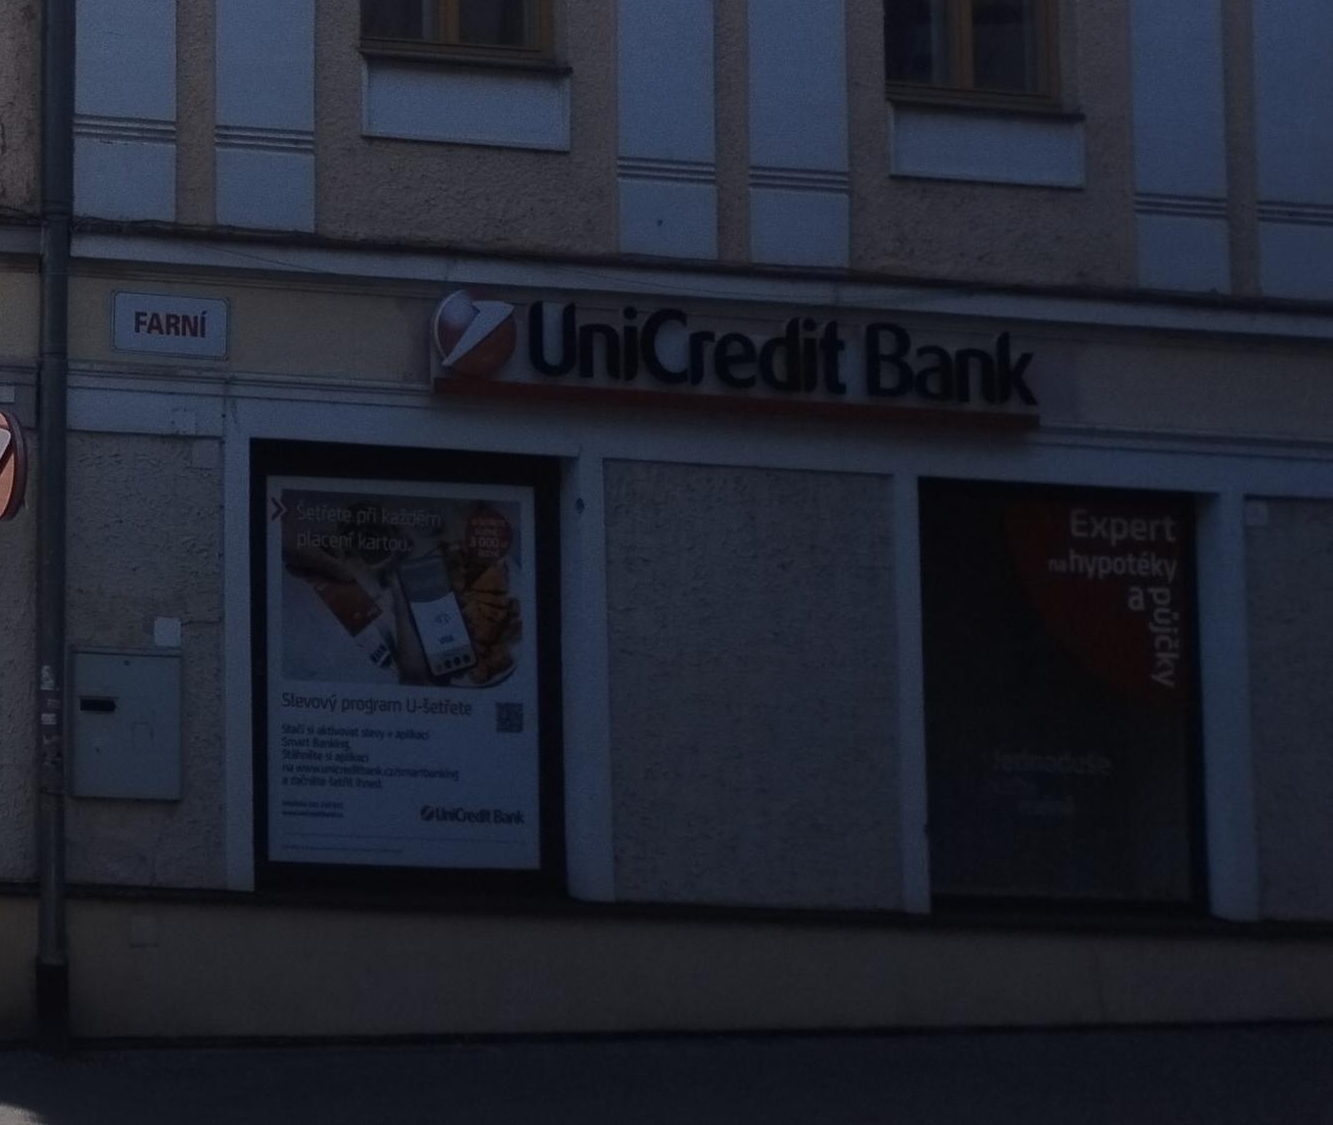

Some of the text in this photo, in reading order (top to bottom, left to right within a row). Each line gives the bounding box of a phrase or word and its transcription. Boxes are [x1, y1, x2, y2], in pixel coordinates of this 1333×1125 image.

[134, 310, 206, 338] FARNÍ
[528, 301, 1037, 406] UniCredit Bank
[296, 501, 442, 527] Šetřete při každém
[1070, 508, 1176, 547] Expert
[296, 531, 412, 552] placení kartou.
[1047, 548, 1177, 584] na hypotéky
[1128, 585, 1146, 611] a
[1147, 586, 1180, 689] půjčky
[282, 692, 473, 715] Slevový program U-šetřete
[436, 806, 525, 825] UniCredit Bank
